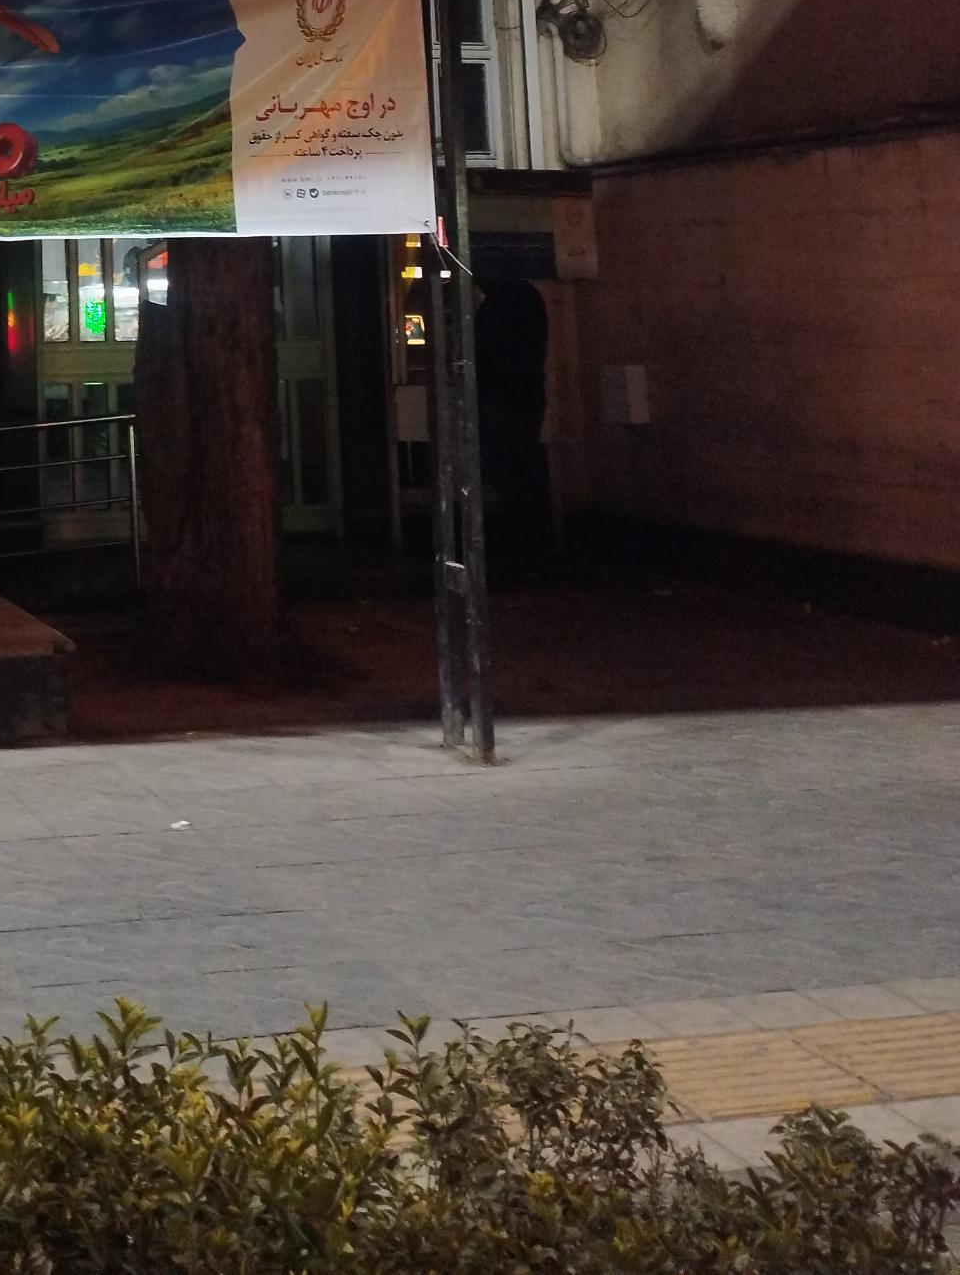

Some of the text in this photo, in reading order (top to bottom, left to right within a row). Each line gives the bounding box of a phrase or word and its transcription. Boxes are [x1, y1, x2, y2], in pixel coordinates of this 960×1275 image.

[255, 92, 396, 122] در اوج مهربانی
